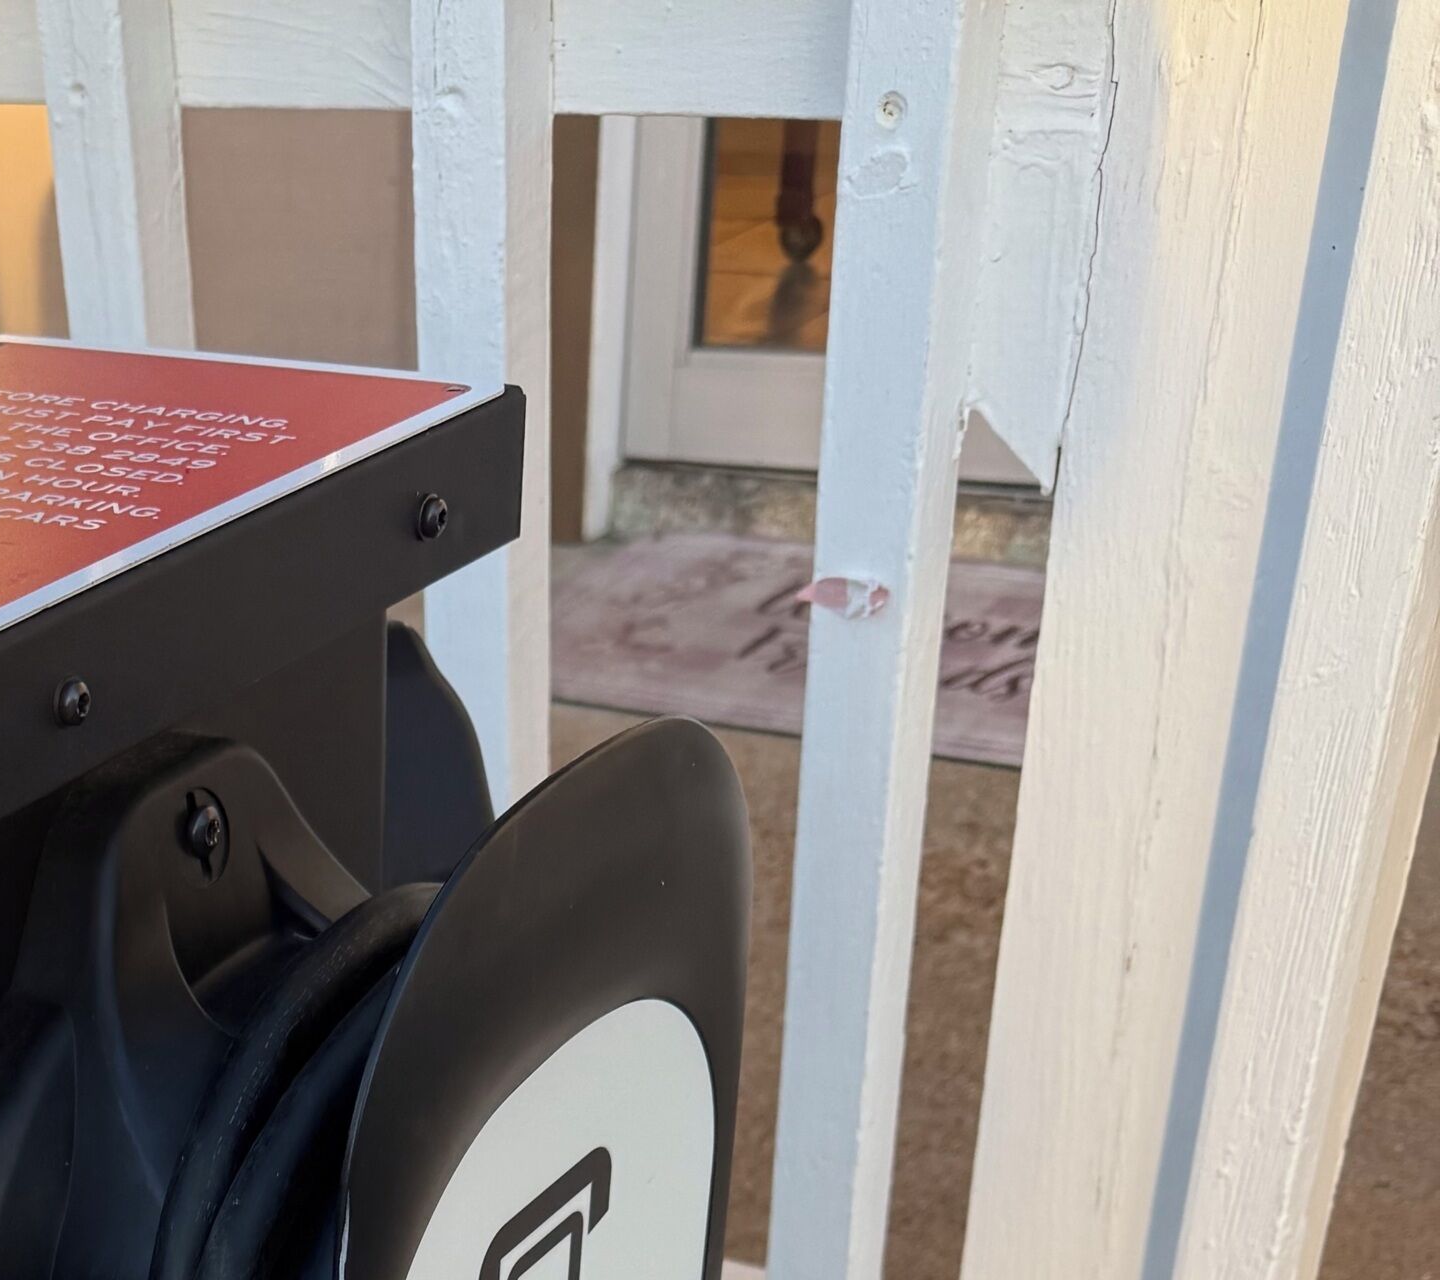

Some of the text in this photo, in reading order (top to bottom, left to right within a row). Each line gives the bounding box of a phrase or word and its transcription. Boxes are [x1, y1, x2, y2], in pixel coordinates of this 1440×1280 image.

[8, 421, 83, 438] THE
[87, 431, 231, 456] OFFICE.
[82, 414, 171, 431] PAY
[173, 424, 297, 445] FIRST
[16, 439, 97, 456] 338
[100, 450, 217, 470] 2849
[22, 474, 142, 498] HOUR.
[24, 457, 184, 486] CLOSED.
